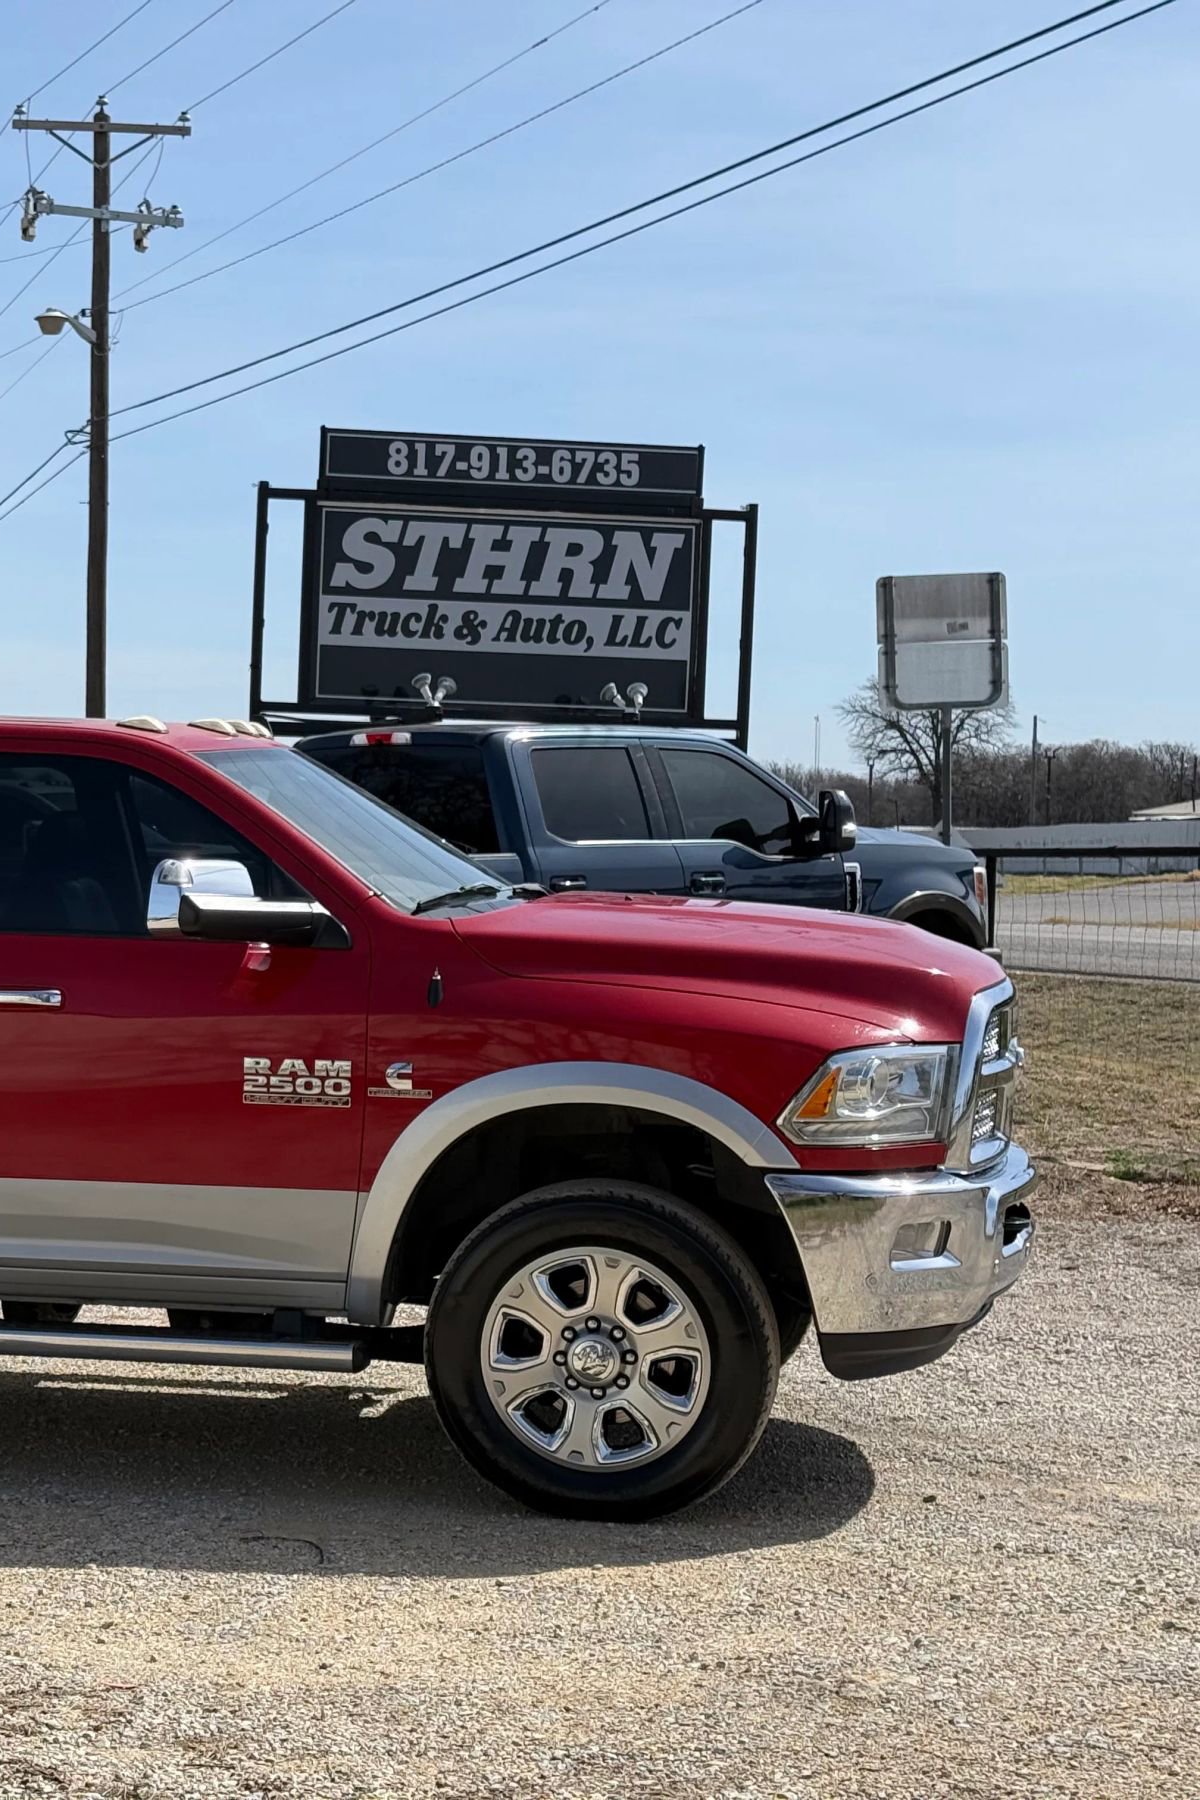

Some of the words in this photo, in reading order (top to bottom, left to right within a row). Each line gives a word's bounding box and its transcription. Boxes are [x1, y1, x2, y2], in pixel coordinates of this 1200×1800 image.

[387, 441, 640, 487] 817-913-6735
[329, 517, 686, 602] STHRN
[327, 602, 449, 640] Truck
[453, 610, 488, 646] &
[491, 609, 595, 653] Auto,
[603, 614, 683, 650] LLC
[243, 1056, 352, 1078] RAM
[243, 1075, 352, 1096] 2500
